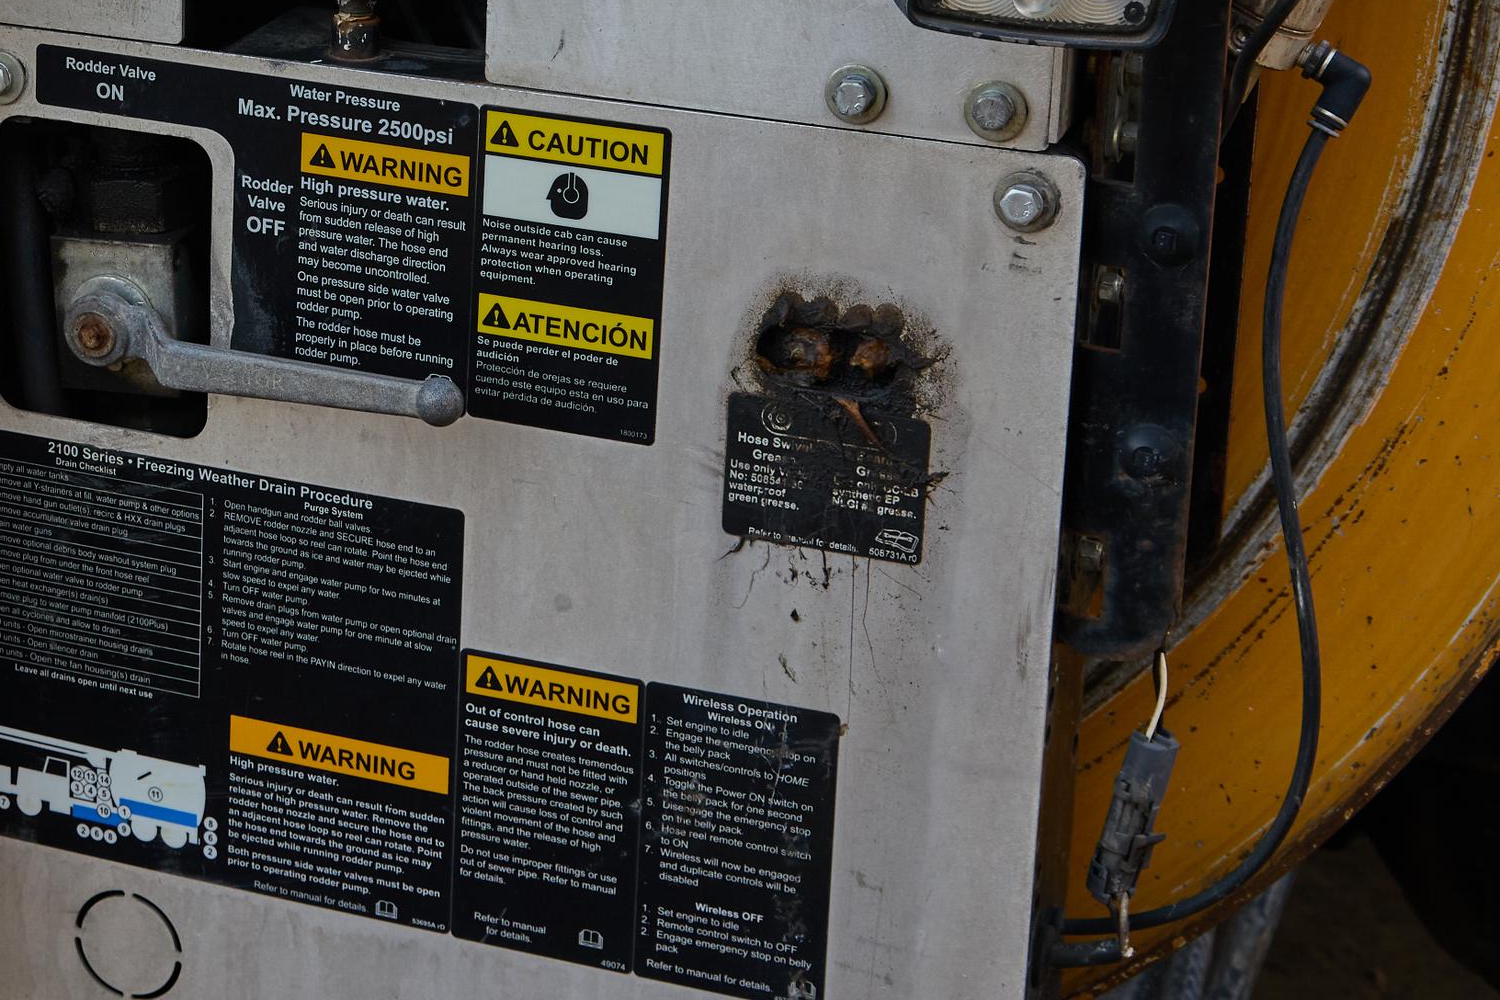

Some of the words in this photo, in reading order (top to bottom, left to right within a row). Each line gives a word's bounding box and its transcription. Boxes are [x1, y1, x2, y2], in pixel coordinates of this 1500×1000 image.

[66, 57, 116, 75] Rodder
[119, 64, 156, 81] Valve
[96, 82, 124, 101] ON
[290, 84, 332, 102] Water
[336, 90, 400, 112] Pressure
[238, 98, 280, 120] Max.
[287, 105, 372, 133] Pressure
[378, 119, 453, 145] 2500psi
[528, 130, 648, 165] CAUTION
[340, 151, 462, 187] WARNING
[242, 175, 294, 194] Rodder
[301, 176, 333, 195] High
[338, 185, 402, 205] pressure
[406, 195, 449, 211] water.
[248, 194, 285, 212] Valve
[246, 216, 285, 236] OFF
[483, 218, 511, 230] Noise
[514, 224, 551, 236] outside
[554, 230, 573, 239] cab
[575, 233, 594, 242] can
[597, 237, 627, 247] cause
[512, 312, 647, 351] ATENCIÓN
[476, 350, 519, 363] audición
[477, 335, 490, 345] Se
[493, 340, 523, 351] puede
[526, 345, 559, 356] perder
[561, 350, 570, 358] el
[573, 353, 603, 363] poder
[606, 356, 618, 366] de
[48, 441, 78, 457] 2100
[82, 447, 124, 465] Series
[137, 457, 194, 481] Freezing
[198, 468, 255, 488] Weather
[259, 479, 295, 496] Drain
[300, 486, 373, 511] Procedure
[56, 457, 77, 468] Drain
[79, 461, 116, 476] Checklist
[304, 502, 329, 515] Purge
[331, 506, 363, 520] System
[505, 674, 630, 715] WARNING
[683, 693, 734, 712] Wireless
[738, 704, 797, 723] Operation
[465, 703, 486, 715] Out
[489, 708, 501, 718] of
[504, 712, 544, 726] control
[548, 718, 576, 732] hose
[579, 726, 600, 737] can
[298, 740, 415, 780] WARNING
[695, 902, 739, 919] Wireless
[742, 912, 763, 923] OFF
